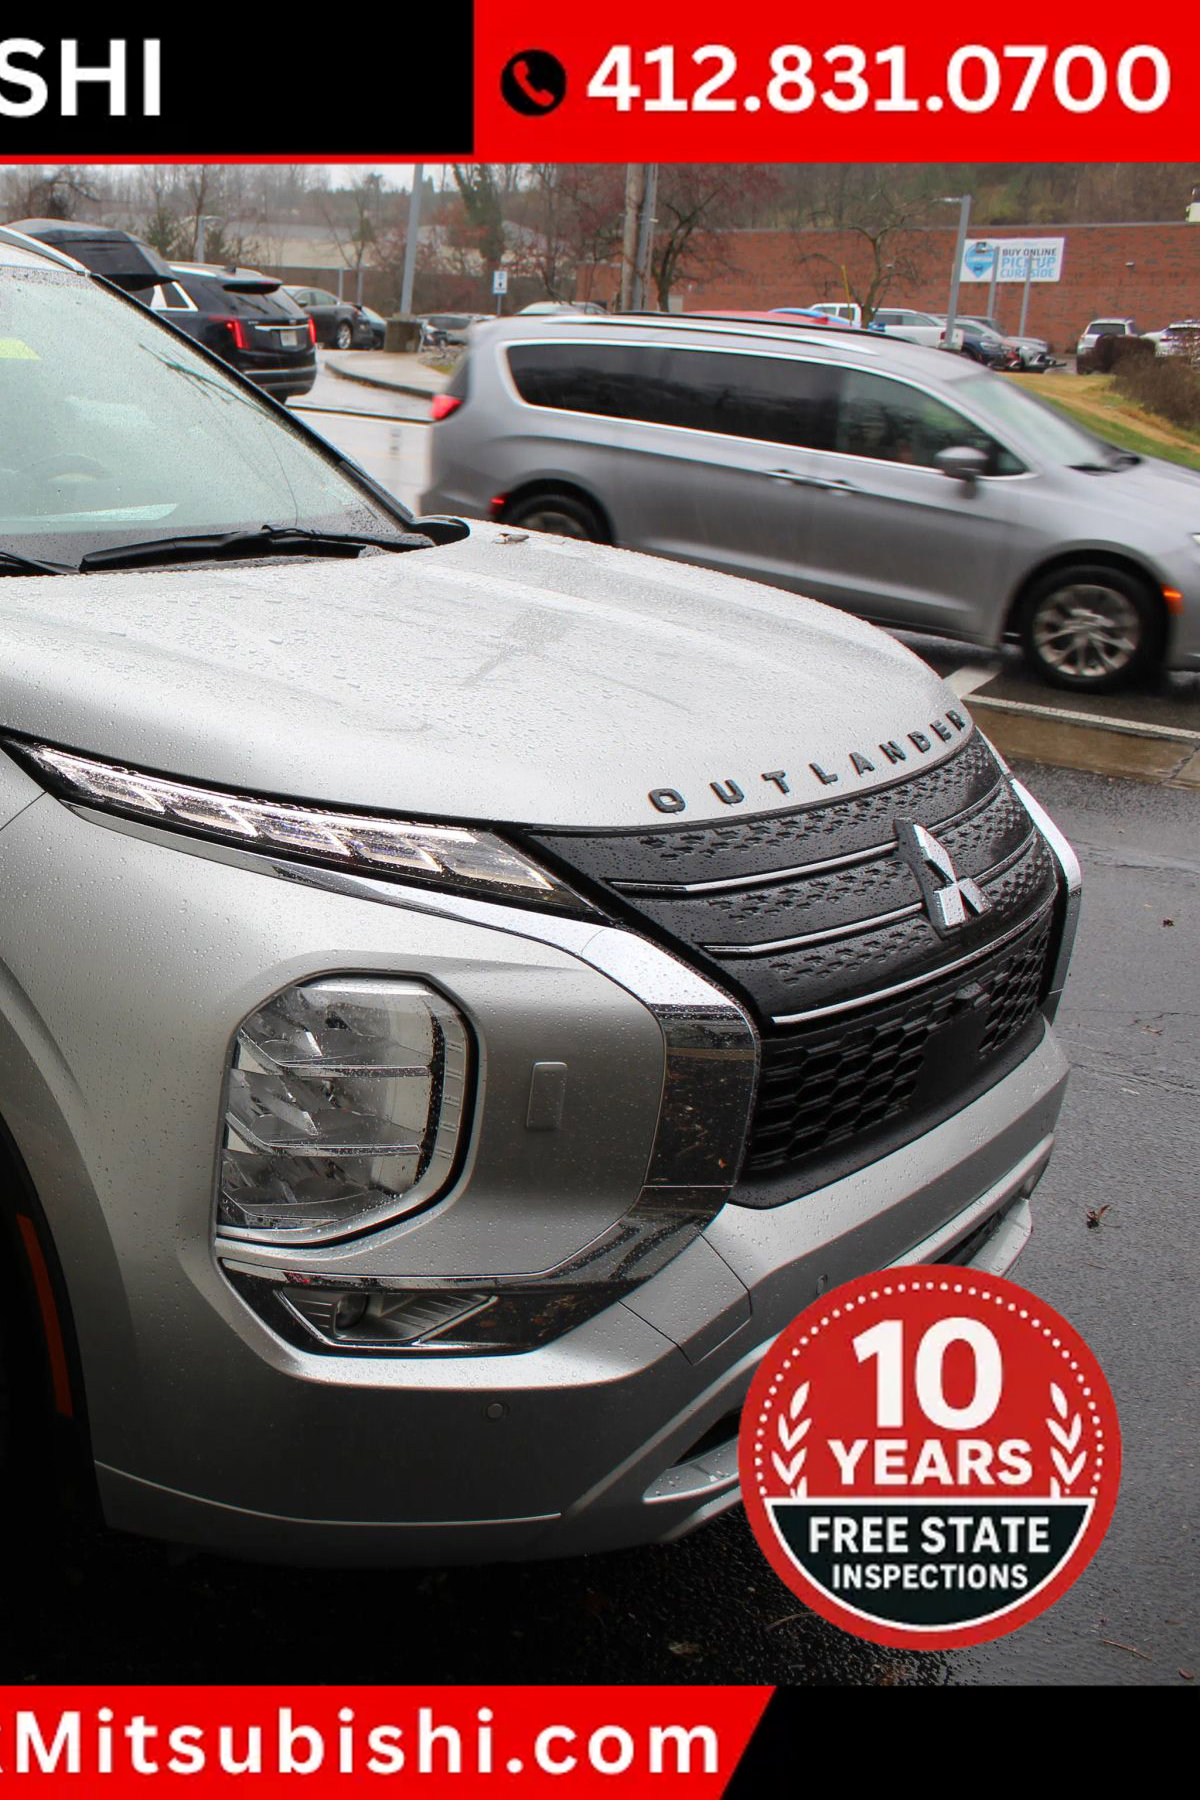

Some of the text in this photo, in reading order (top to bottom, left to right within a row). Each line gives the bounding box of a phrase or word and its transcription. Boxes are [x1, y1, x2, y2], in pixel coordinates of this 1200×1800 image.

[1002, 248, 1057, 256] BUY ONLINE
[649, 709, 966, 814] OUTLANDER
